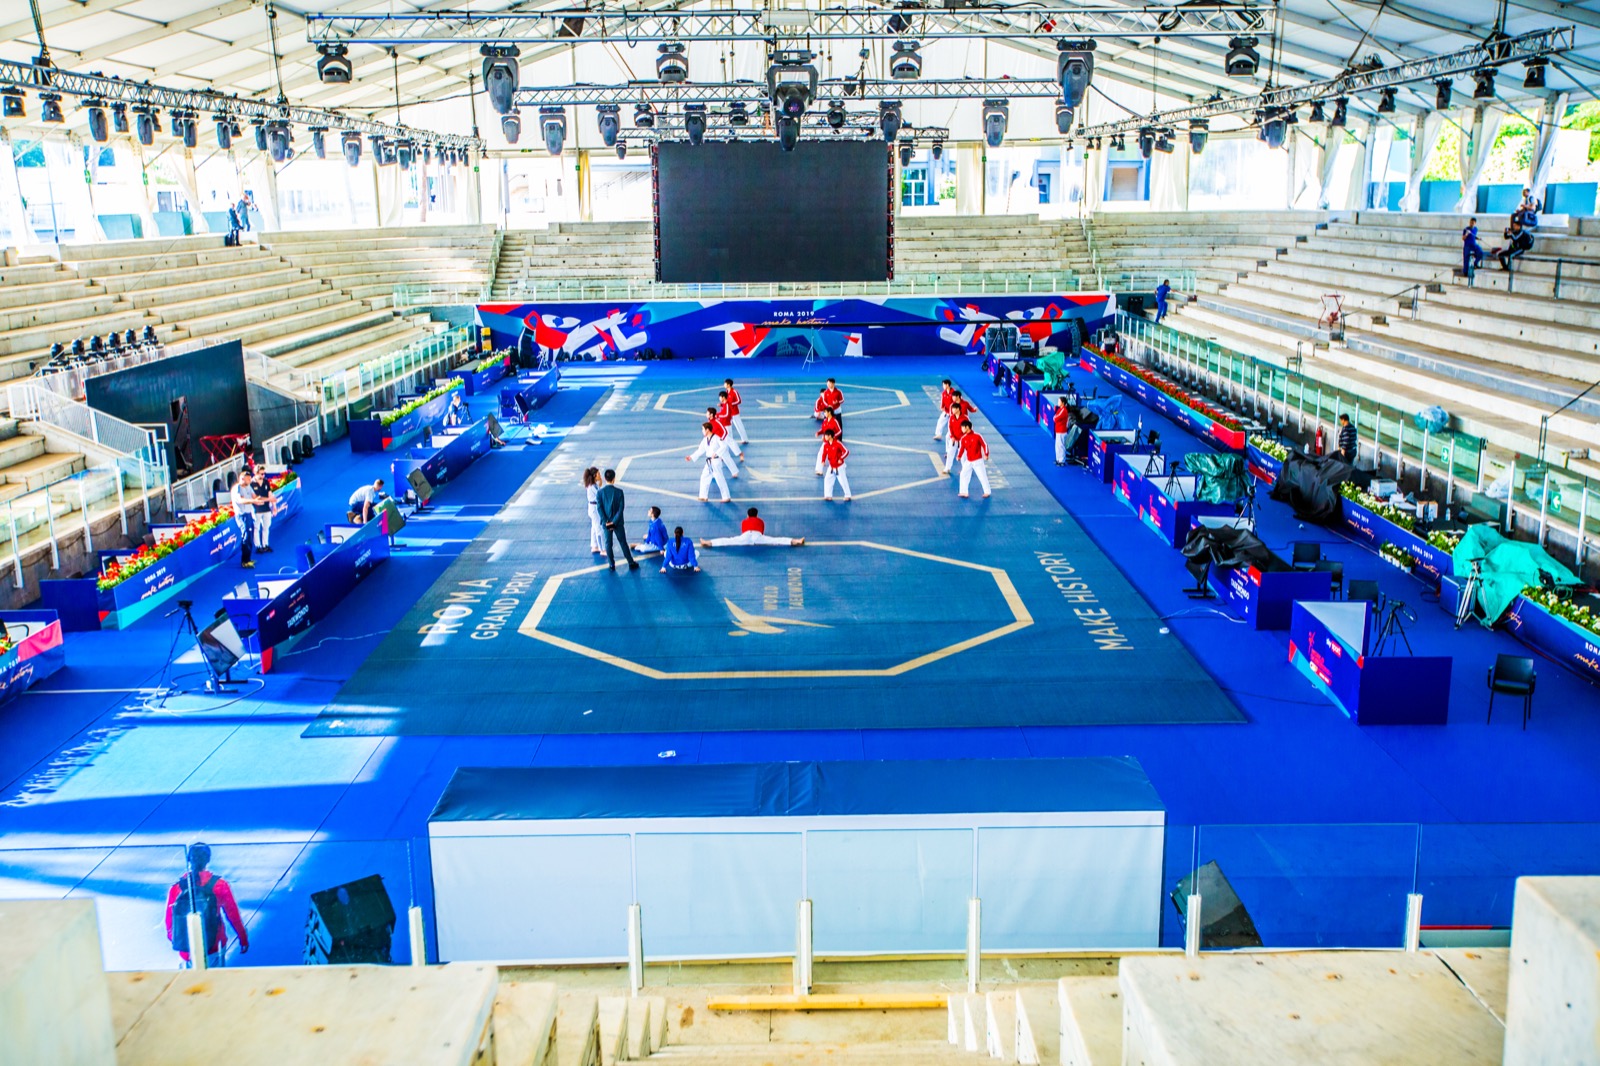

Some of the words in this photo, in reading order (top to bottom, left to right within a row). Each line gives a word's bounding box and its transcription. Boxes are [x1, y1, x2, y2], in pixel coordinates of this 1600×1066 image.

[1034, 550, 1100, 603] HISTORY
[1412, 544, 1423, 555] ROMA
[1423, 549, 1434, 560] 2019
[417, 577, 499, 635] ROMA
[470, 597, 520, 641] GRAND
[501, 570, 539, 595] PRIX
[1073, 608, 1135, 651] MAKE
